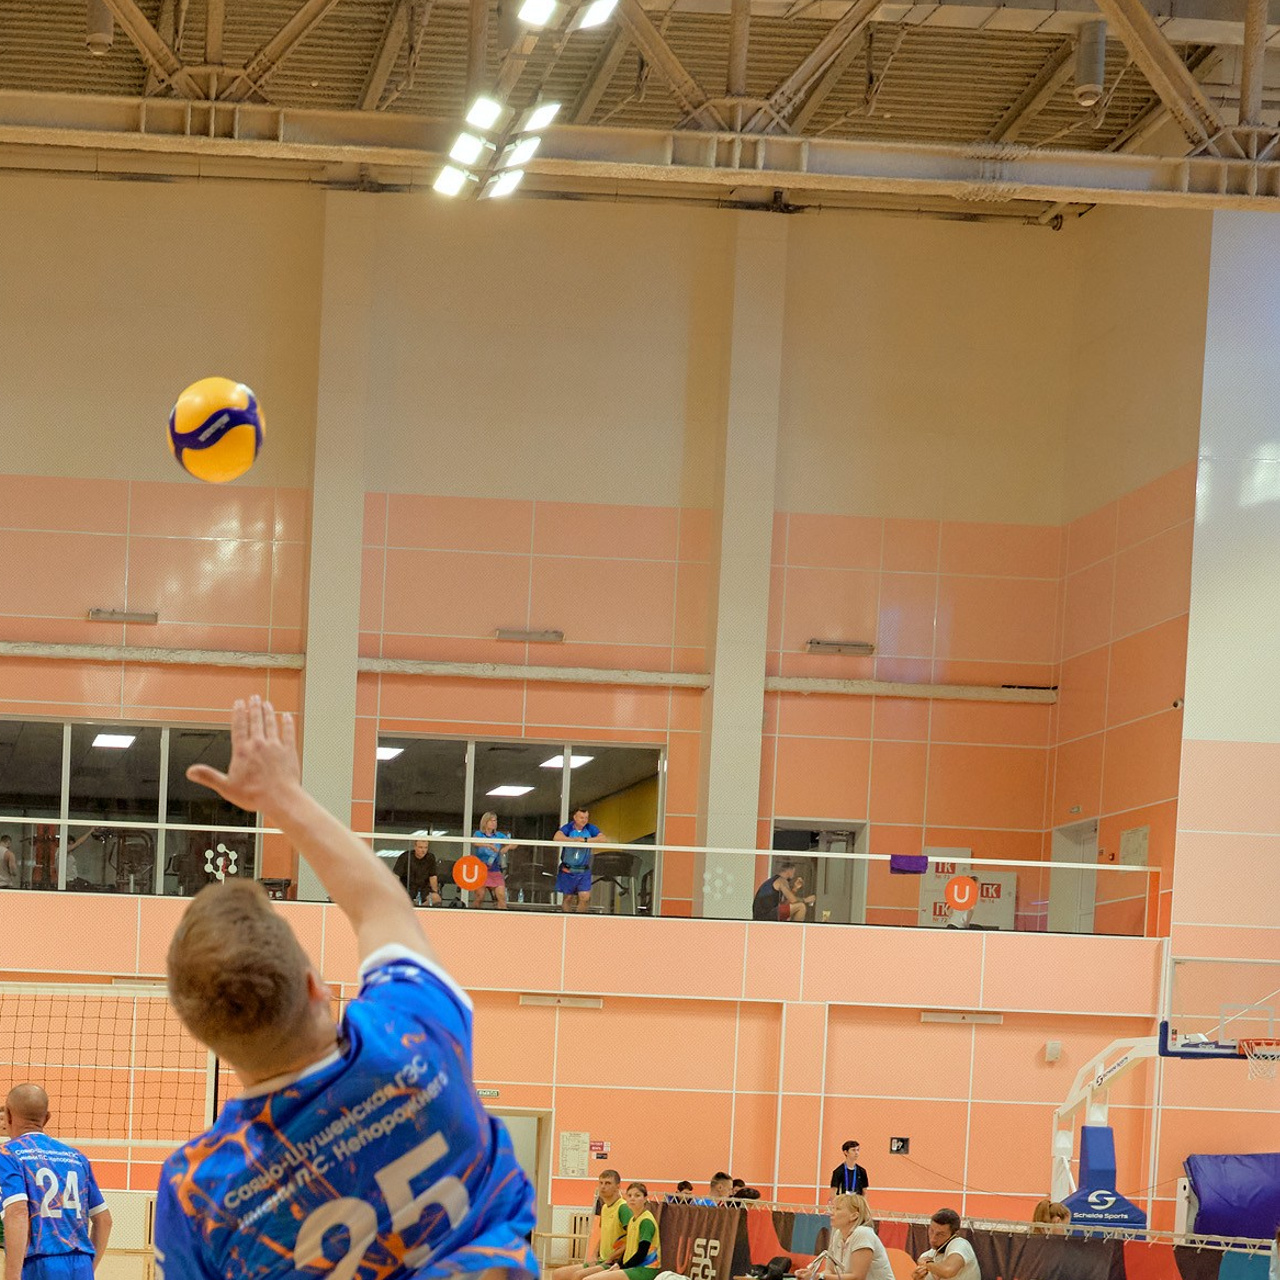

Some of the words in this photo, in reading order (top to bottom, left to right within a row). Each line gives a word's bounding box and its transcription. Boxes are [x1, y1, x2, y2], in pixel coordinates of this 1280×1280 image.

[462, 864, 478, 883] U
[953, 885, 970, 903] U
[223, 1085, 397, 1209] Саяно-Шушенская
[394, 1055, 428, 1089] ГЭС
[35, 1167, 82, 1219] 24
